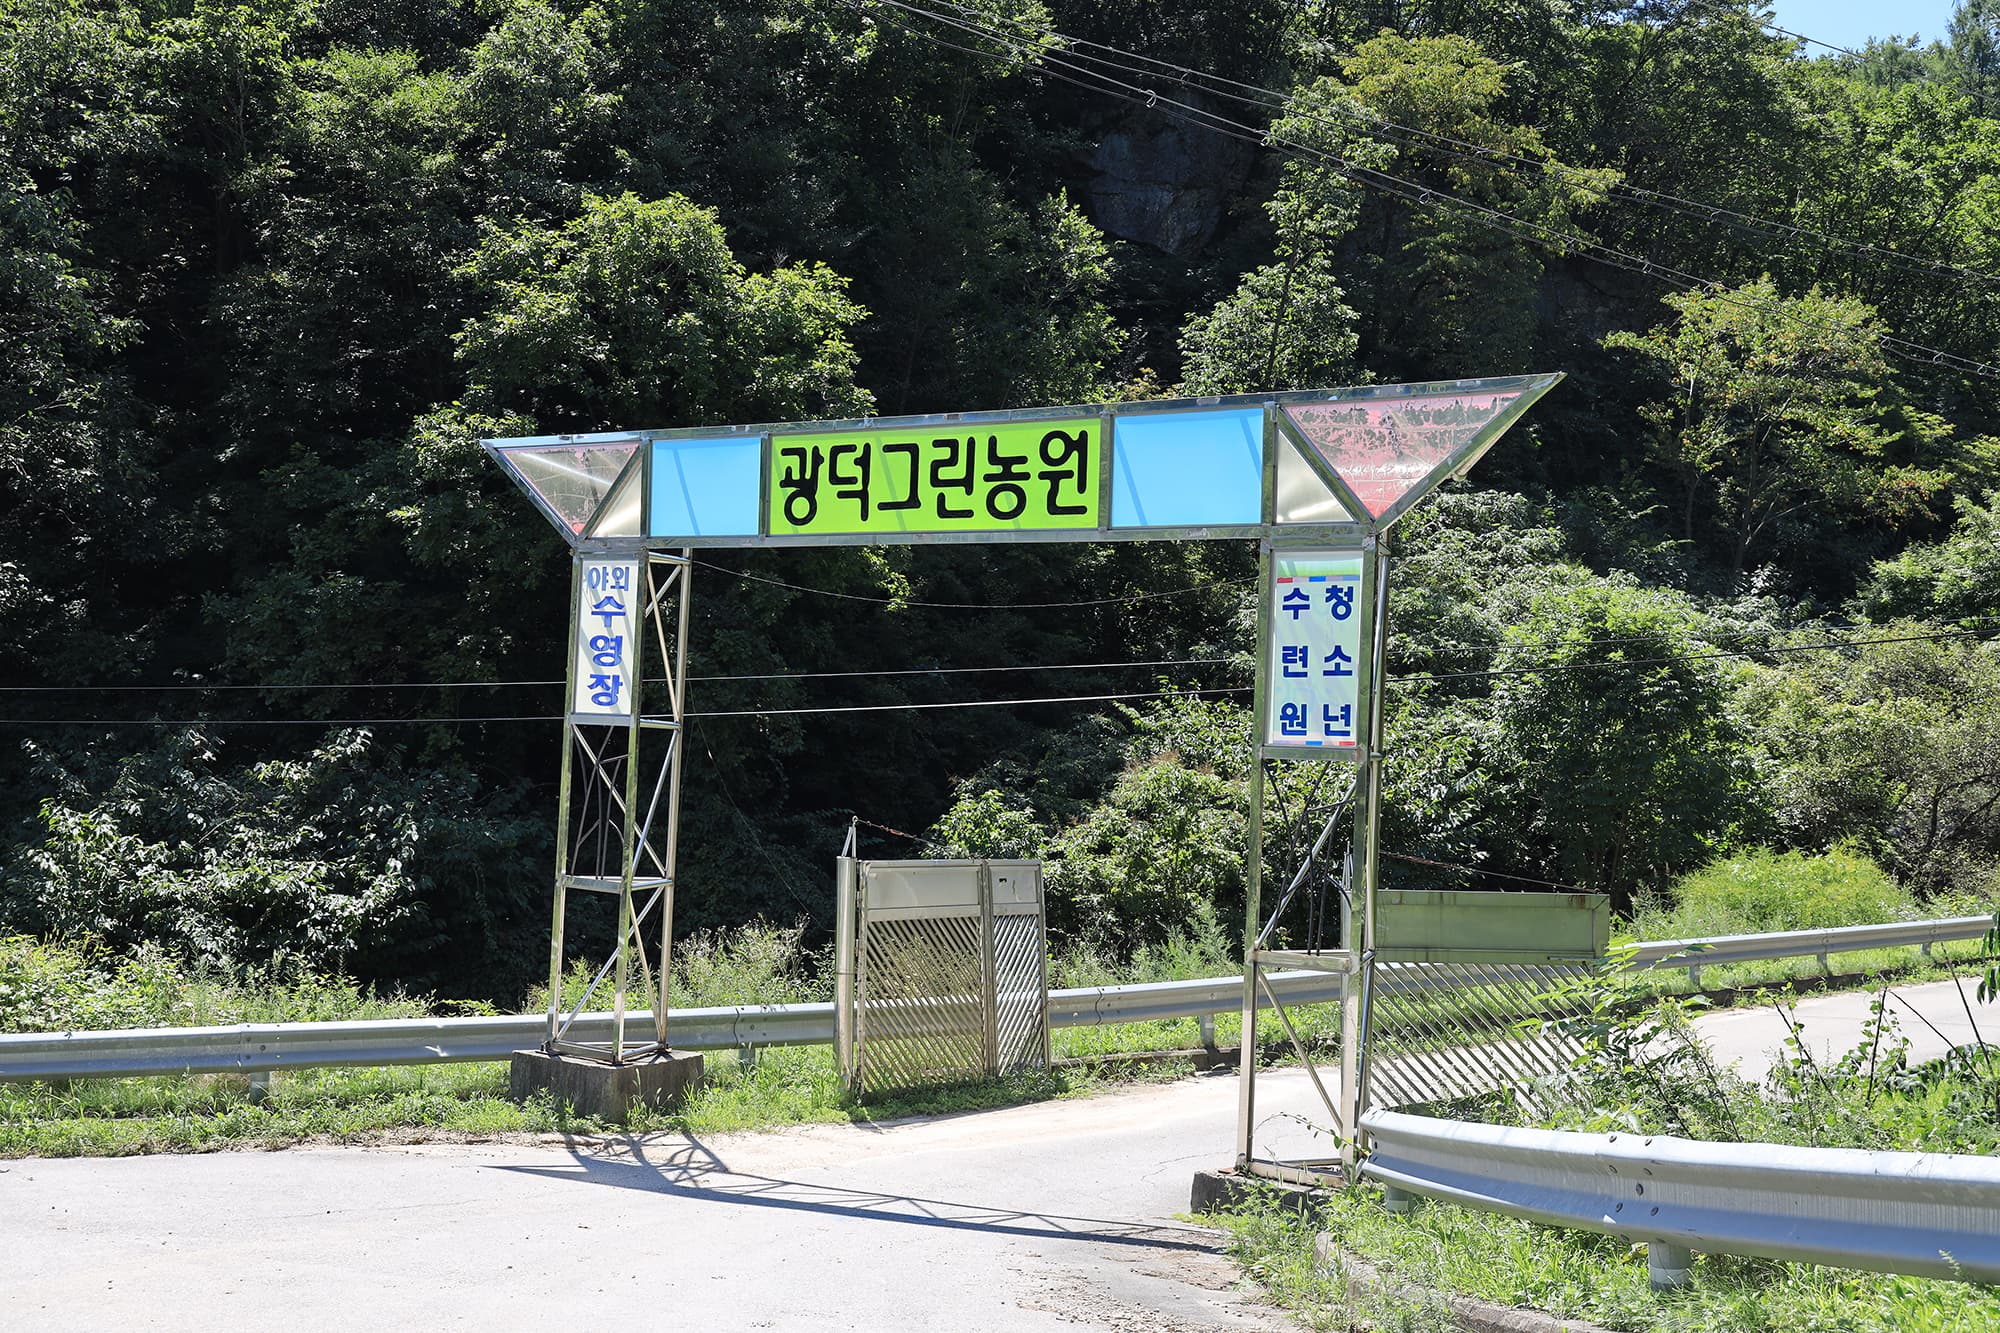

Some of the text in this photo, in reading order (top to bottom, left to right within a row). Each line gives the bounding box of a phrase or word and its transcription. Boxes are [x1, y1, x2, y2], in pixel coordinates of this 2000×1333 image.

[779, 429, 1088, 526] 광덕그린농원
[588, 566, 630, 591] 야외
[587, 596, 626, 706] 수영장
[1280, 587, 1310, 736] 수련원
[1323, 585, 1354, 736] 청소년
